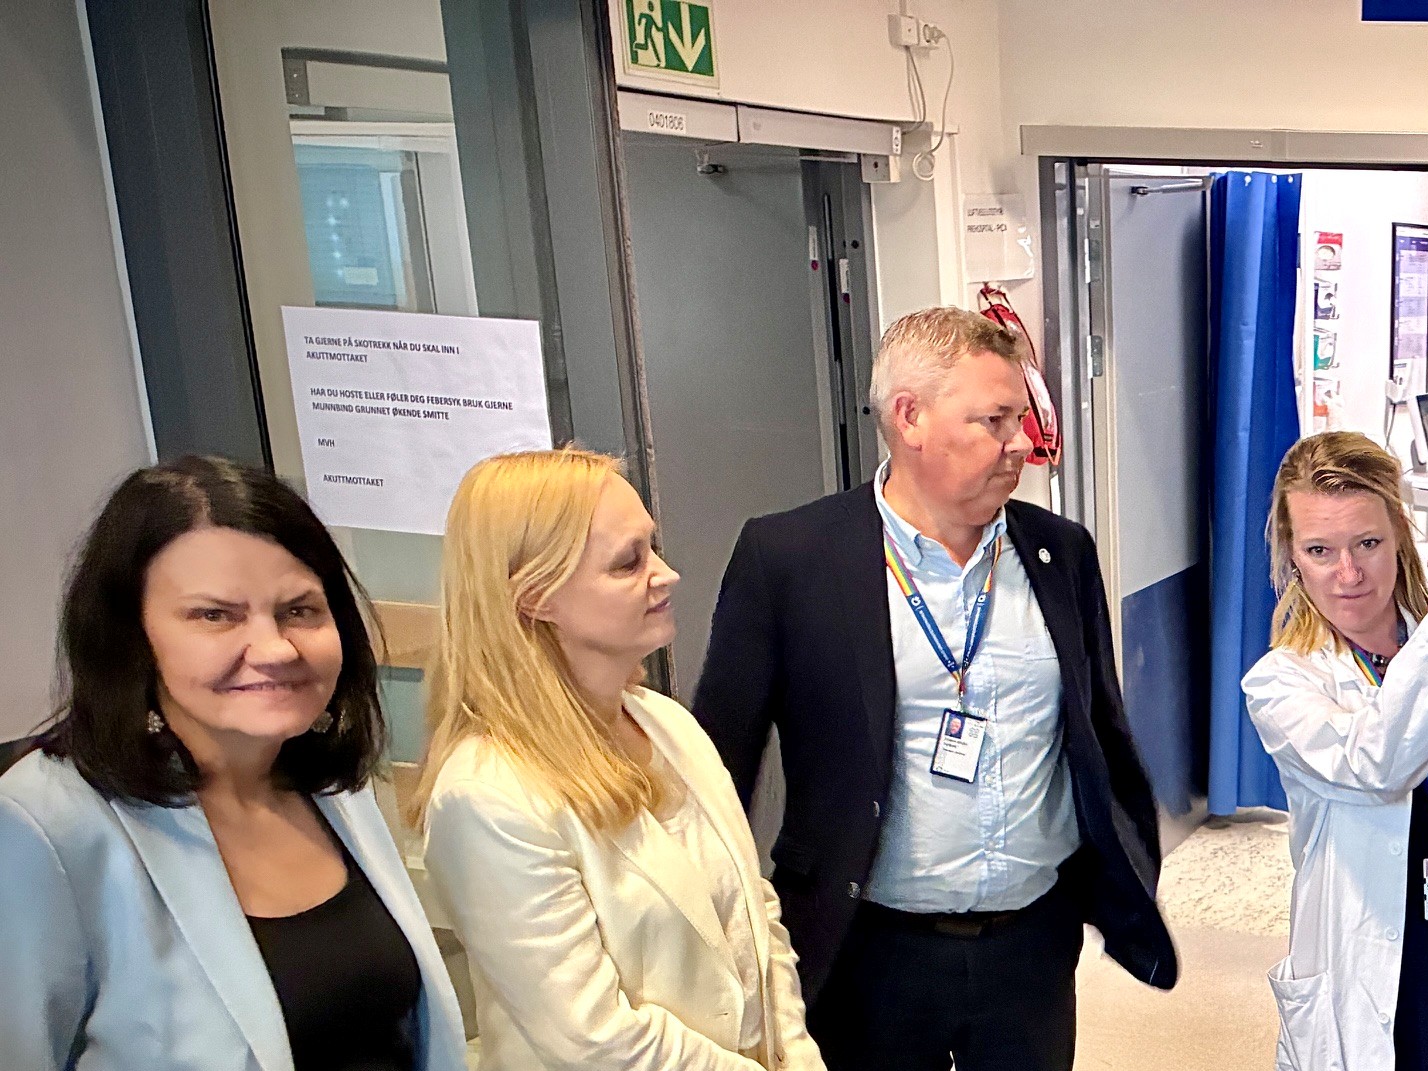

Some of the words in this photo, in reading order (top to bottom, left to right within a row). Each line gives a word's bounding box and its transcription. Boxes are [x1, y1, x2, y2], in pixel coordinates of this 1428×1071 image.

[304, 336, 314, 345] TA
[315, 337, 341, 347] GJERNE
[343, 337, 353, 347] PÅ
[354, 339, 391, 350] SKOTREKK
[393, 340, 408, 351] NÅR
[410, 342, 421, 352] DU
[422, 344, 440, 353] SKAL
[441, 345, 455, 354] INN
[306, 351, 368, 363] AKUTTMOTTAKET
[310, 387, 326, 397] HAR
[327, 388, 338, 397] DU
[339, 390, 363, 400] HOSTE
[364, 391, 385, 401] ELLER
[386, 392, 409, 403] FØLER
[410, 394, 425, 404] DEG
[426, 396, 460, 406] FEBERSYK
[462, 398, 483, 408] BRUK
[484, 400, 513, 410] GJERNE
[312, 402, 354, 413] MUNNBIND
[355, 404, 390, 415] GRUNNET
[392, 407, 421, 418] ØKENDE
[423, 410, 449, 420] SMITTE
[317, 438, 335, 448] MVH
[323, 474, 384, 487] AKUTTMOTTAKET
